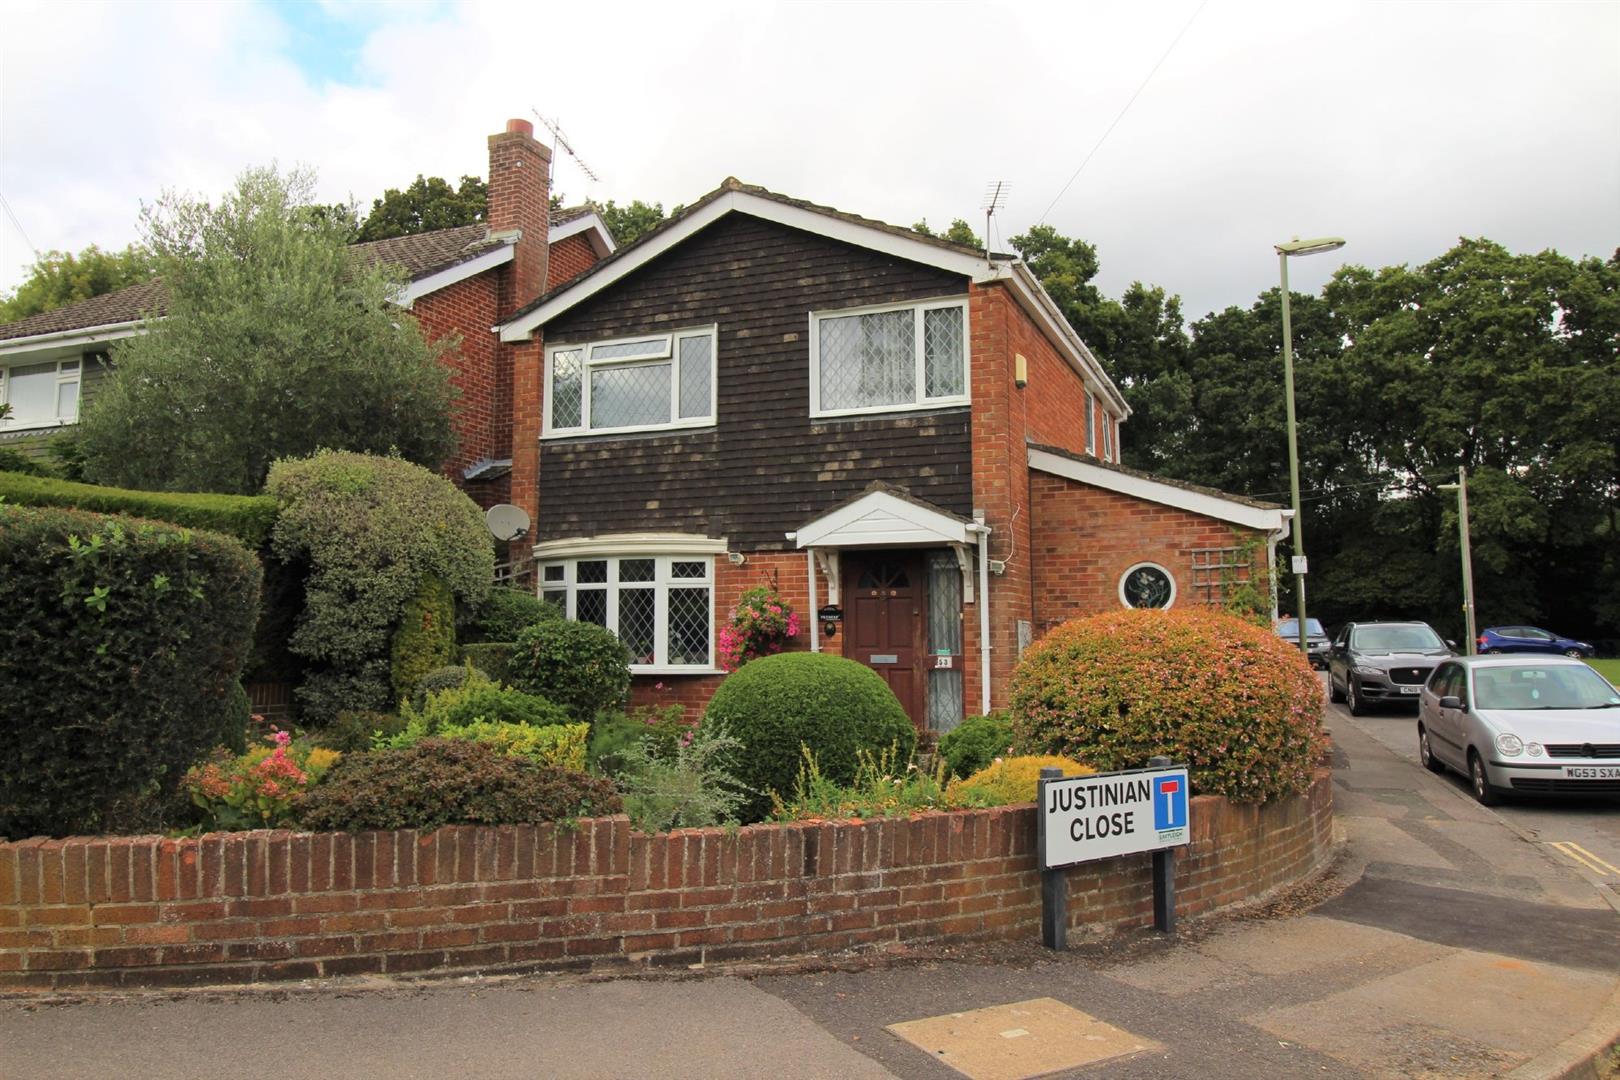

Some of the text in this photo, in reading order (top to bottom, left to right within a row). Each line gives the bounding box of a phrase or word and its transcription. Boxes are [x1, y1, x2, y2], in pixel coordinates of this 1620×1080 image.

[1566, 767, 1620, 778] WG53 SXA
[1049, 779, 1151, 814] JUSTINIAN
[1070, 811, 1135, 842] CLOSE
